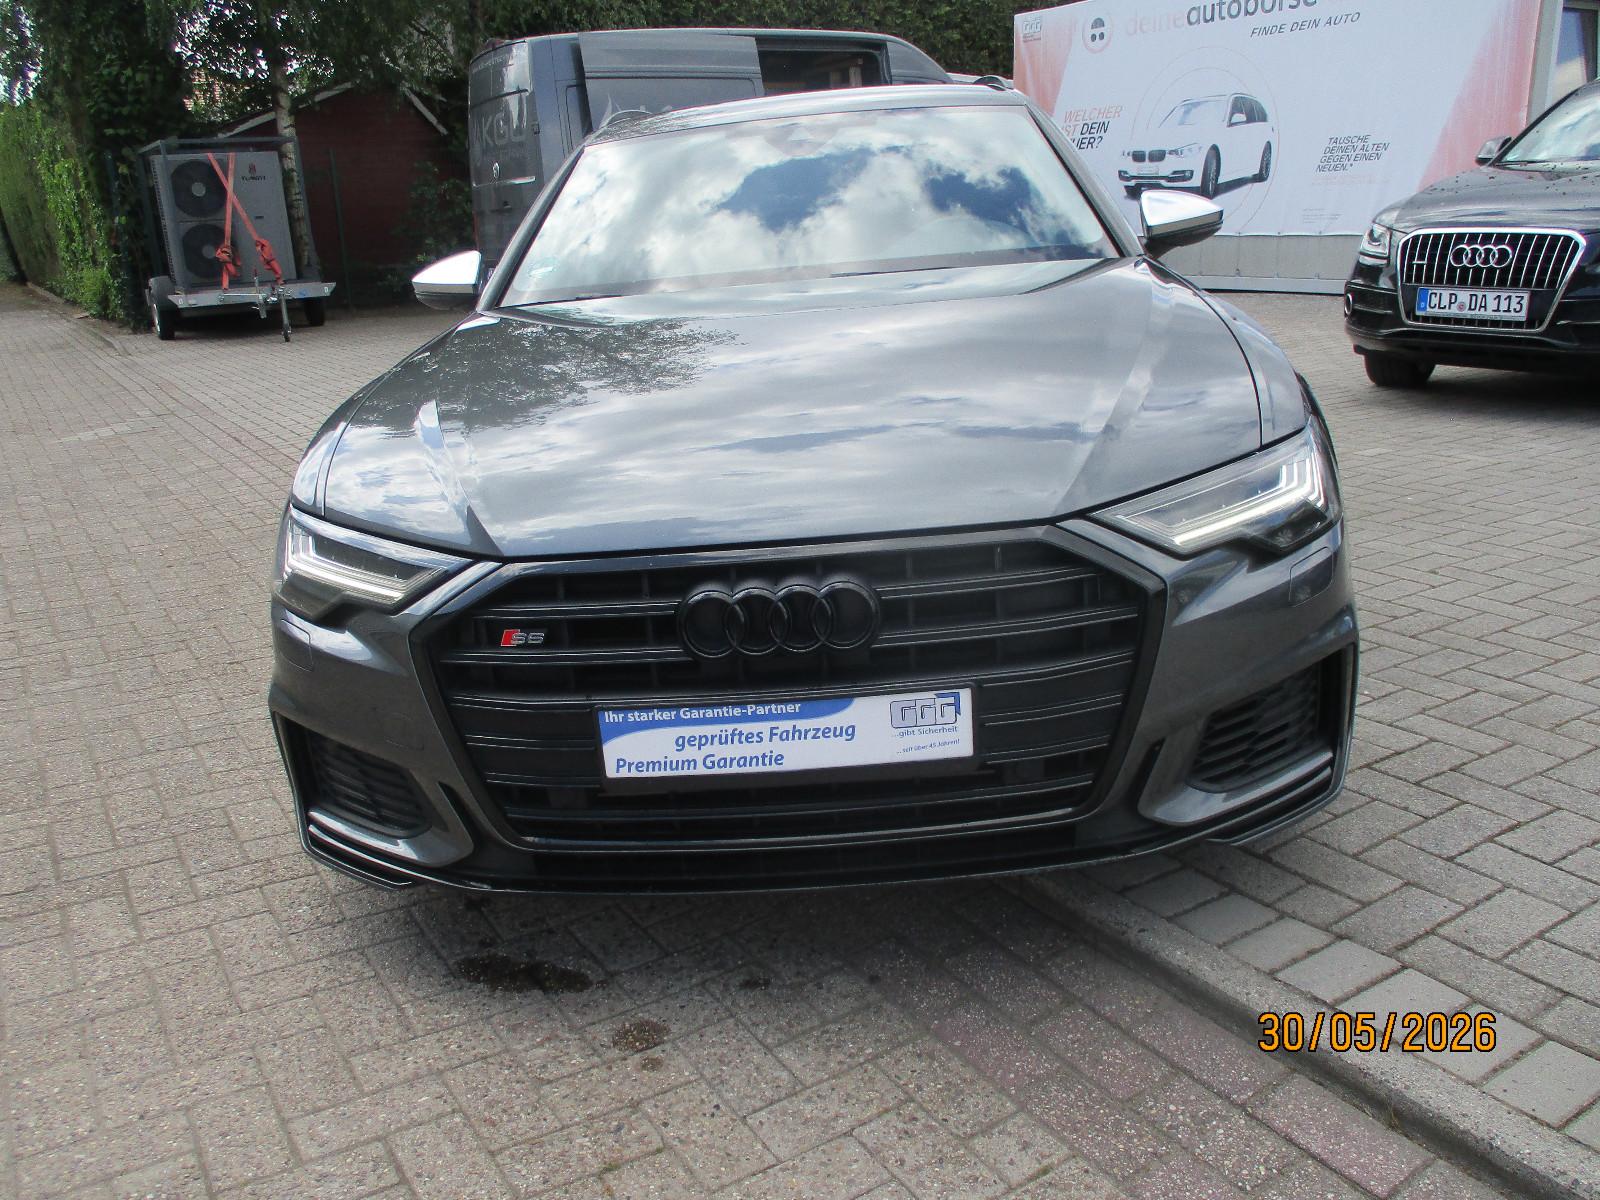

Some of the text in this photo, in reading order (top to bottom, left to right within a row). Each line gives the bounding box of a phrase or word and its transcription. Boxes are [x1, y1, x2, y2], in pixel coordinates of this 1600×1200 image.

[1250, 11, 1361, 38] FINDE DEIN AUTO
[1064, 104, 1122, 123] WELCHER
[1080, 120, 1110, 136] DEIN
[1323, 142, 1391, 155] DEINEN ALTEN
[1328, 134, 1372, 146] TAUSCHE
[1320, 151, 1382, 164] GEGEN EINEN
[1428, 291, 1458, 310] CLP
[1468, 293, 1488, 312] DA
[1491, 294, 1525, 314] 113
[604, 703, 802, 723] Ihr starker Garantie-Partner
[674, 724, 856, 752] geprüftes Fahrzeug
[917, 725, 958, 736] Sicherheit
[615, 750, 785, 773] Premium Garantie
